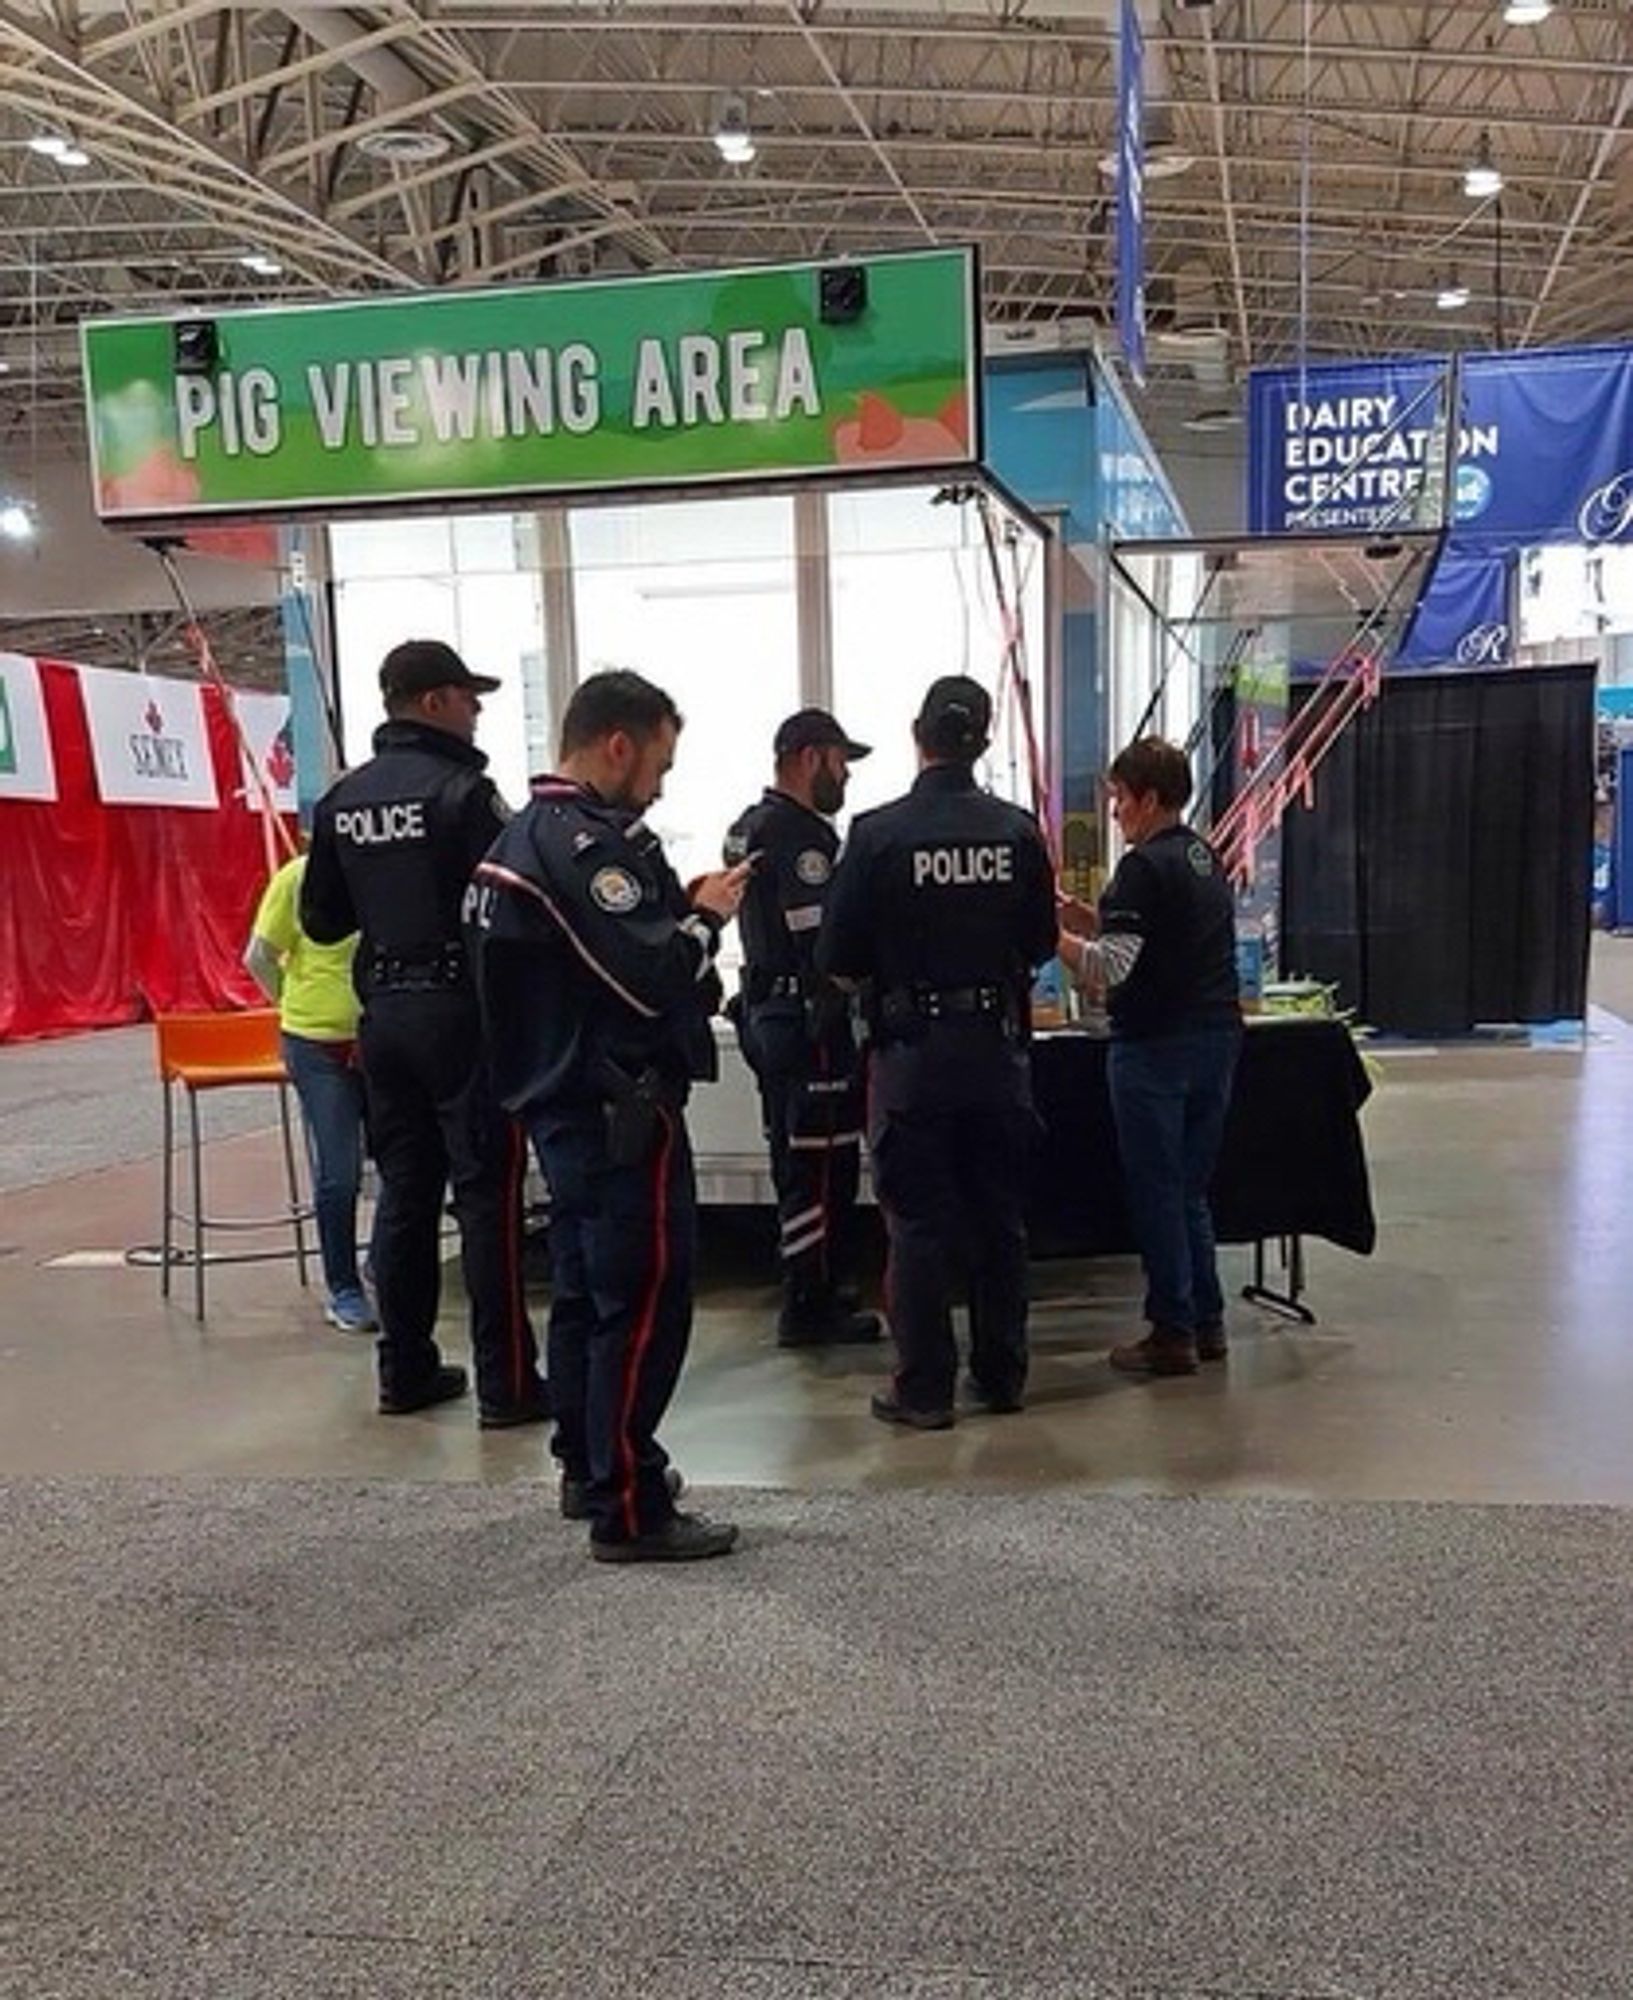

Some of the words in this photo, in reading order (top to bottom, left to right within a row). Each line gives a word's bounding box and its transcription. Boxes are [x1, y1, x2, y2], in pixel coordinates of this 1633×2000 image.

[175, 367, 281, 461] PIG
[307, 343, 600, 452] VIEWING
[631, 326, 821, 431] AREA
[1286, 395, 1398, 432] DAIRY
[1285, 425, 1499, 468] EDUCATN
[334, 803, 426, 845] POLICE
[913, 846, 1013, 887] POLICE
